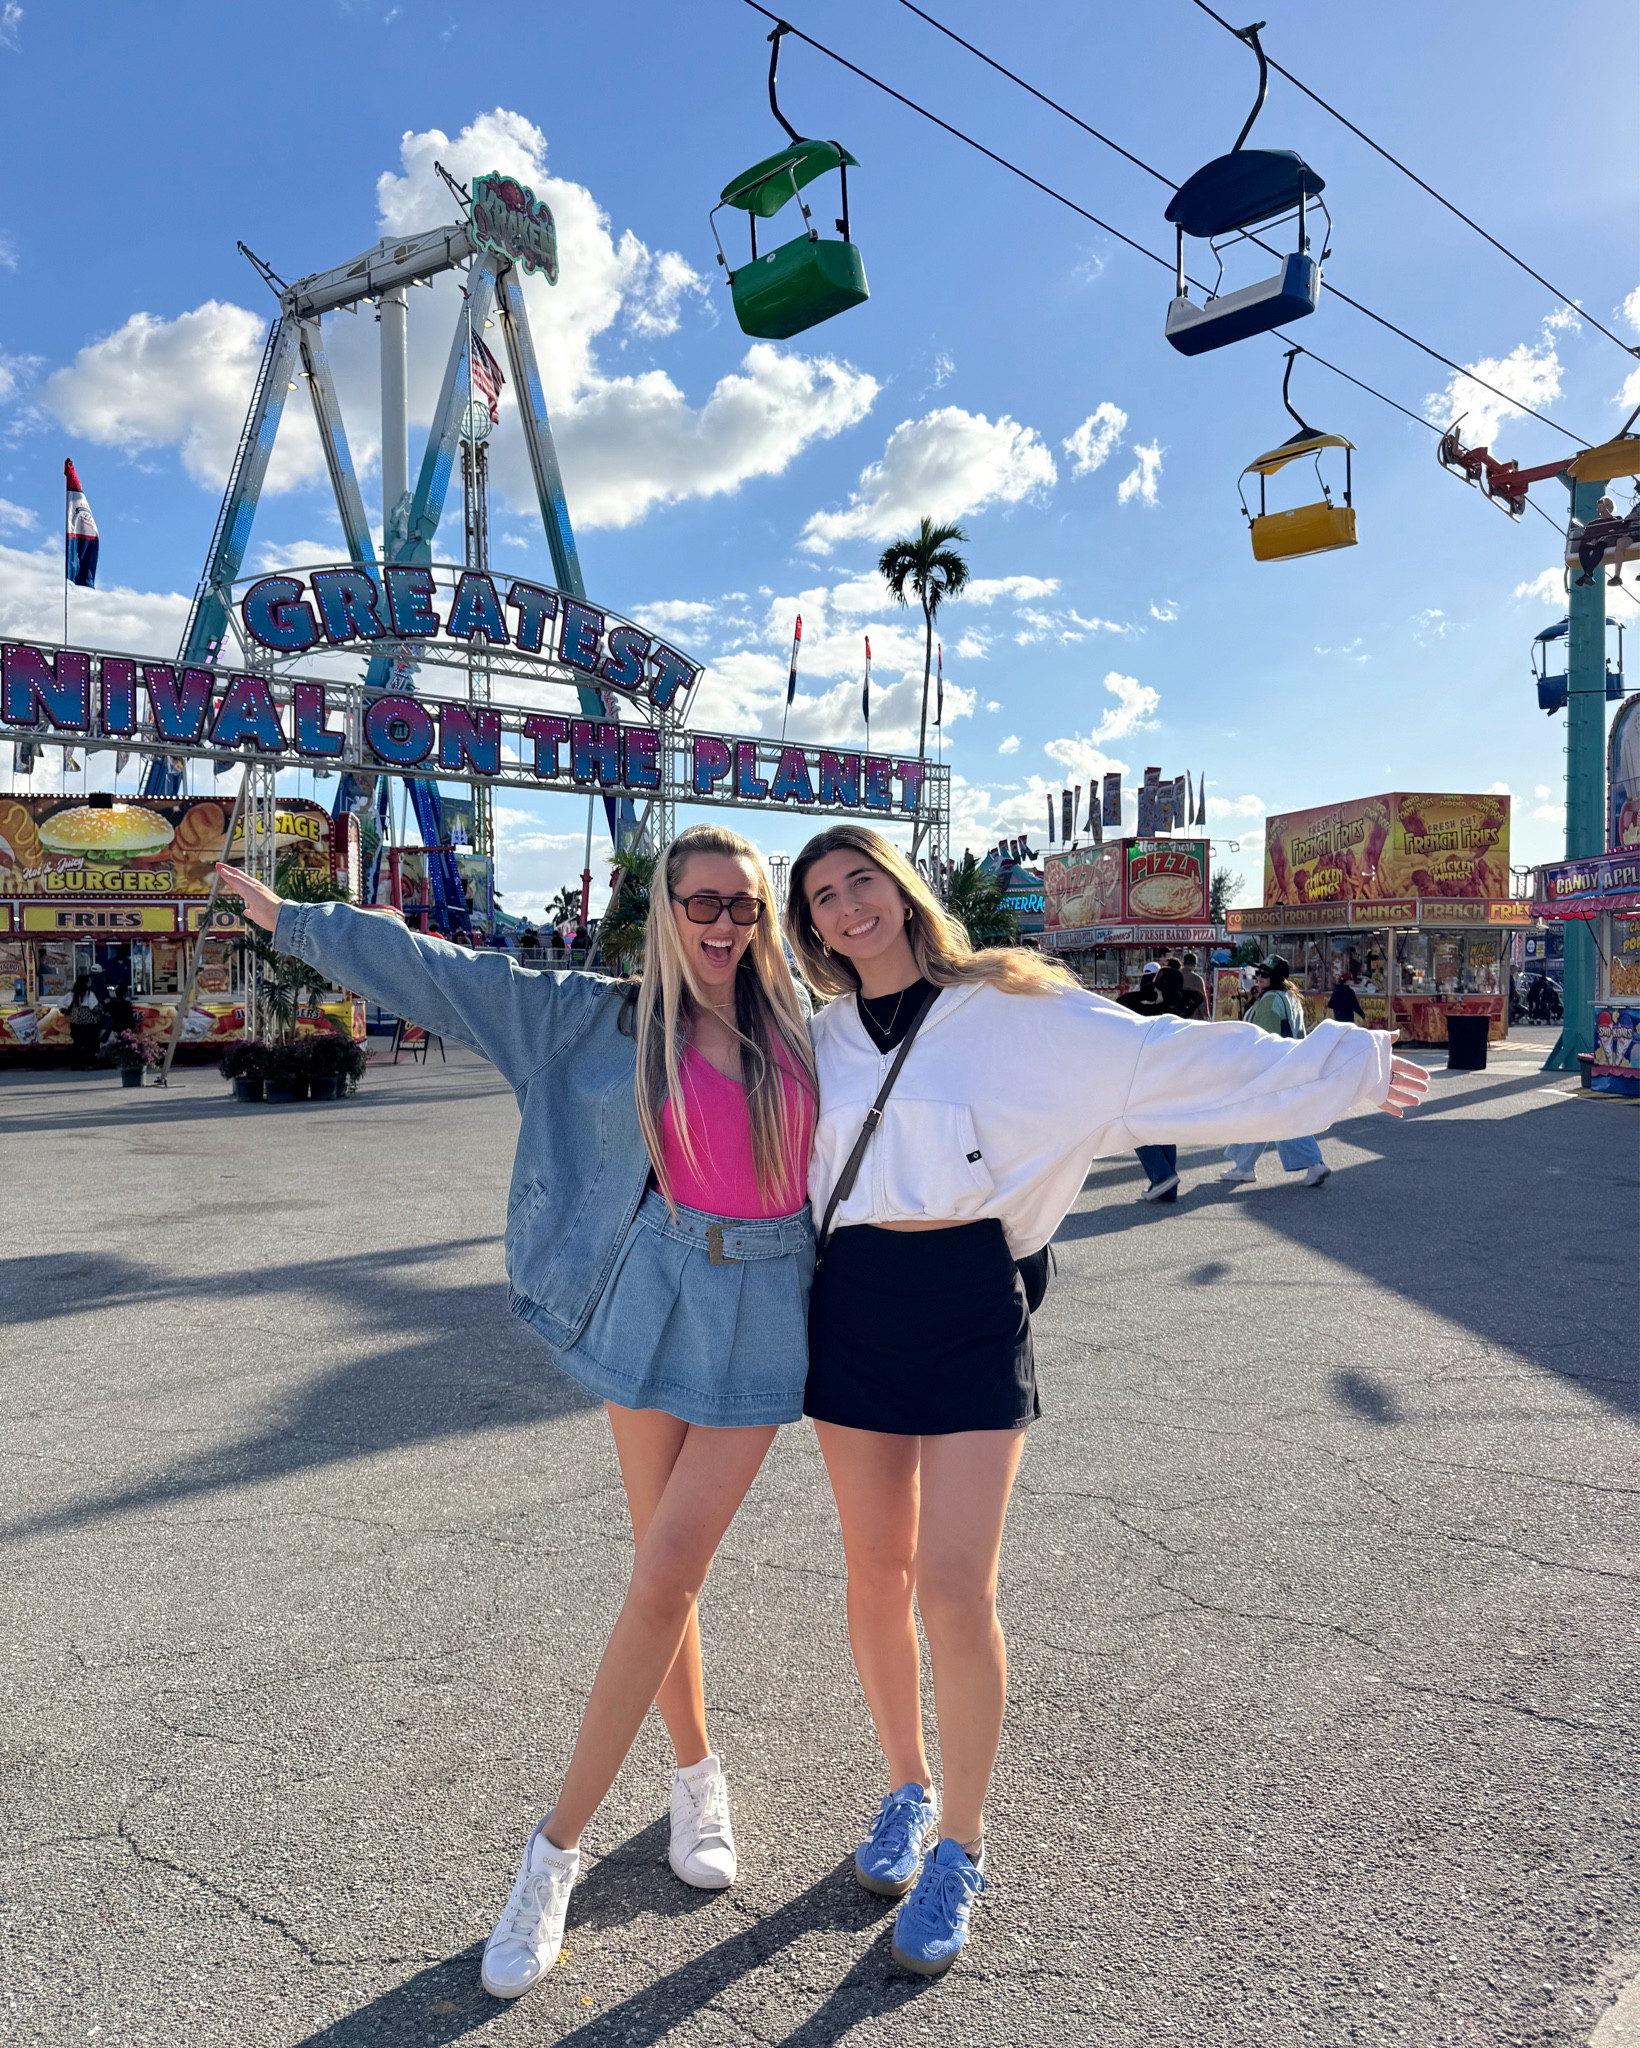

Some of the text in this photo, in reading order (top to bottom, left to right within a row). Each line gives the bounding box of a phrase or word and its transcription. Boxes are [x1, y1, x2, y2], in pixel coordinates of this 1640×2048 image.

[478, 182, 555, 257] KRAKEN
[242, 567, 697, 711] GREATEST
[1, 643, 926, 813] NIVAL ON THE PLANET
[1308, 817, 1331, 837] FRESH
[1332, 805, 1347, 824] CUT
[1427, 814, 1477, 833] FRESH CUT
[1291, 831, 1332, 867] FRENCH
[1333, 818, 1364, 851] FRIES
[1404, 825, 1499, 855] FRENCH FRIES
[23, 866, 42, 881] Hot
[54, 856, 85, 875] Juicy
[1130, 851, 1203, 885] PIZZA
[1304, 868, 1343, 891] CHICKEN
[1428, 860, 1475, 876] CHICKEN
[1433, 870, 1473, 883] WINGS
[46, 870, 172, 893] BURGERS
[1308, 881, 1340, 900] WINGS
[1556, 872, 1599, 895] CANDY
[57, 911, 142, 929] FRIES
[1228, 911, 1281, 926] CORN DOGS
[1284, 906, 1347, 922] FRENCH FRIES
[1355, 903, 1414, 921] WINGS
[1423, 902, 1531, 920] FRENCH FRIES
[1140, 928, 1166, 941] FRESH
[1166, 928, 1191, 941] BAKED
[1191, 928, 1215, 941] PIZZA
